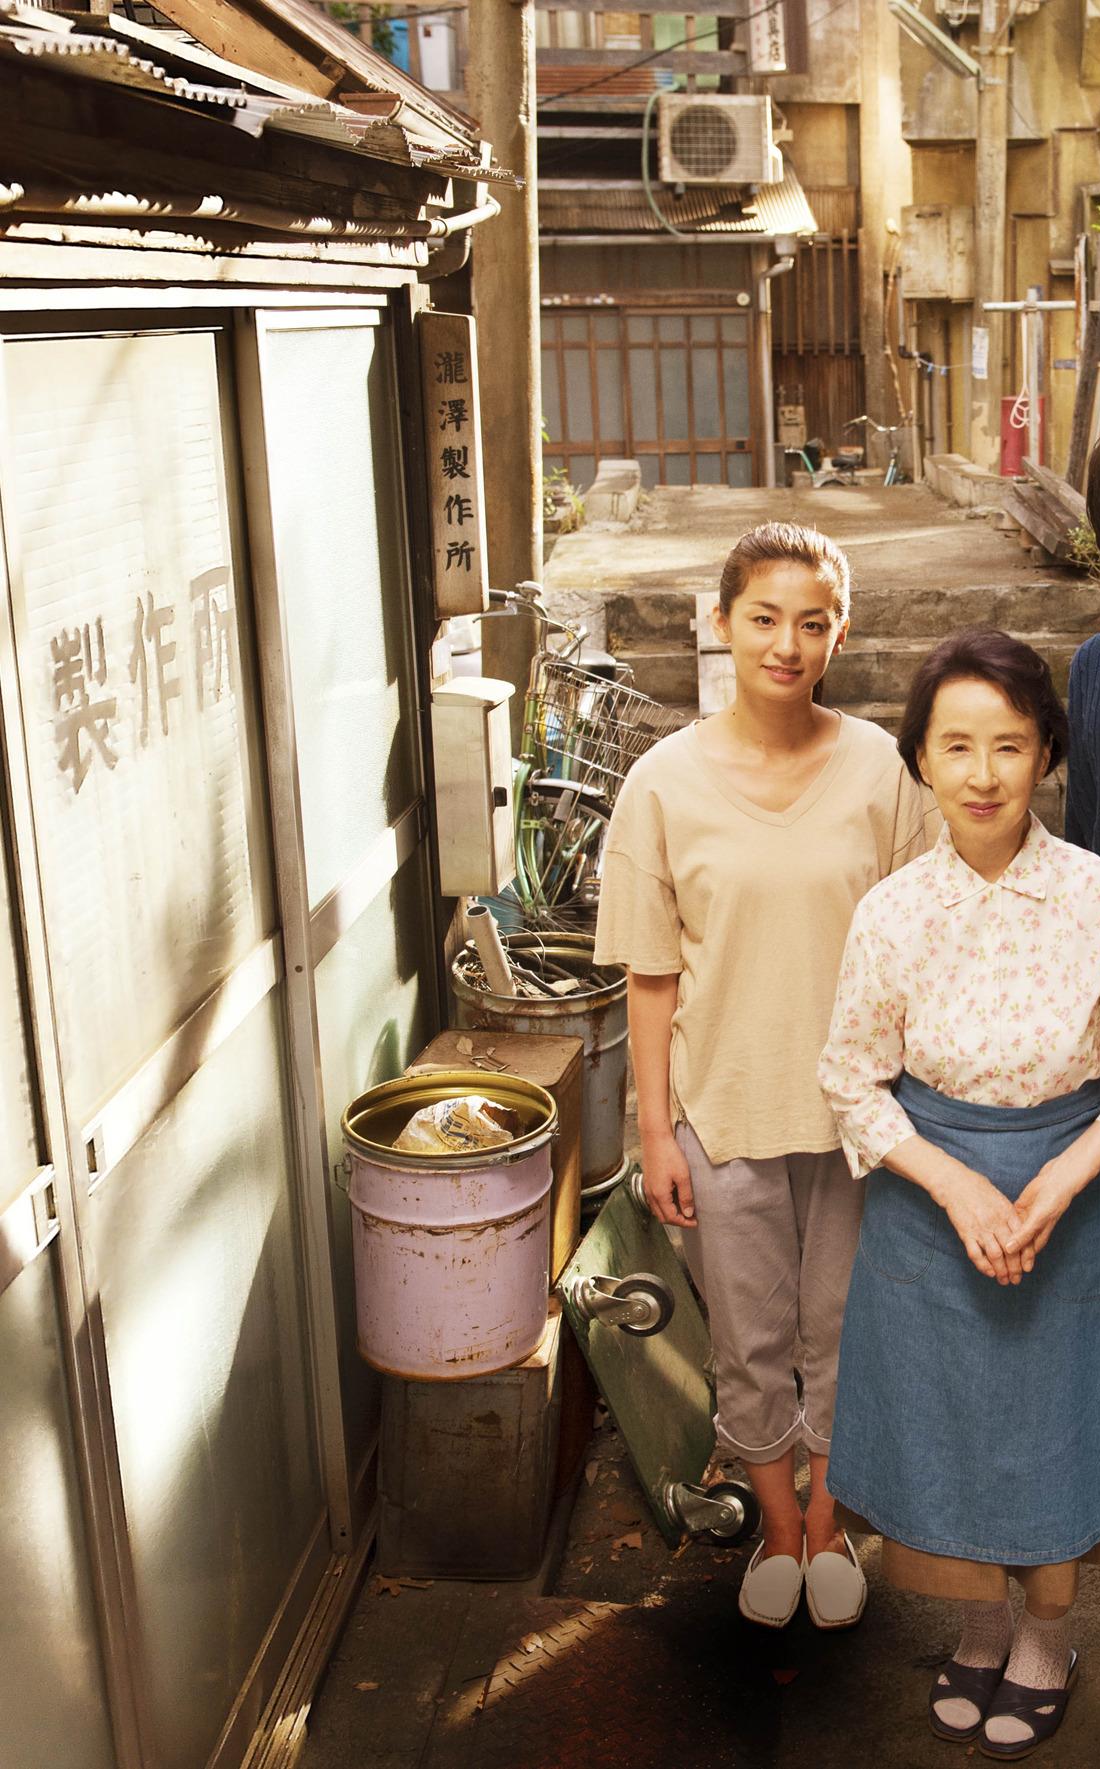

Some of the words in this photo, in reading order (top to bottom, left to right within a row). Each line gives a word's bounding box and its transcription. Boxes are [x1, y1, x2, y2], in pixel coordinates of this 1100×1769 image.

[434, 351, 476, 572] 瀧澤製作所
